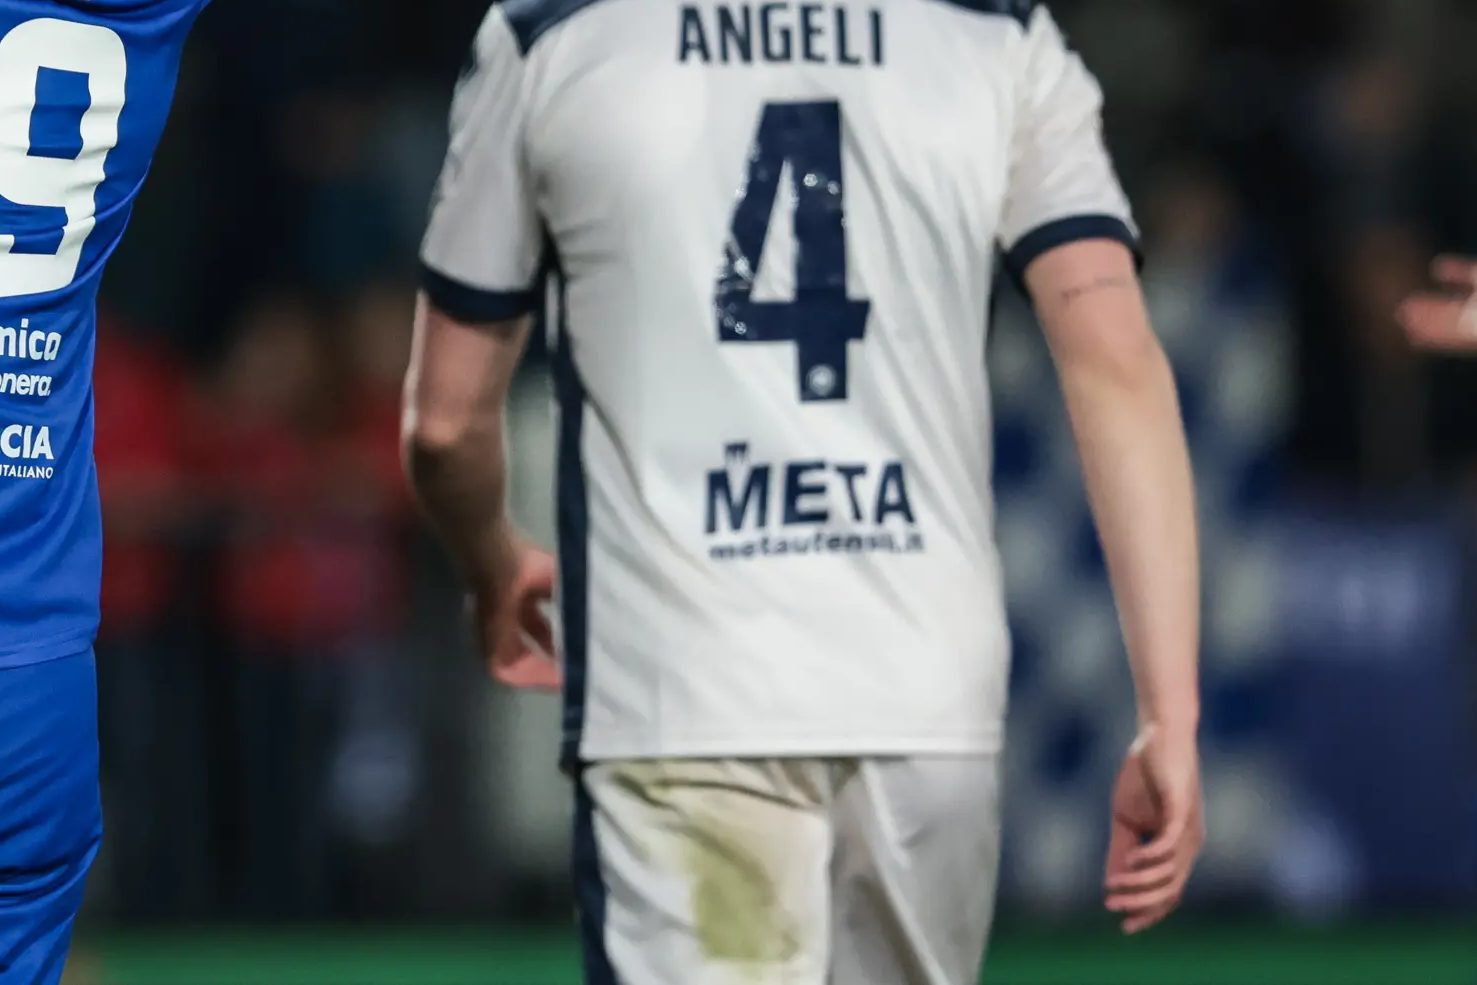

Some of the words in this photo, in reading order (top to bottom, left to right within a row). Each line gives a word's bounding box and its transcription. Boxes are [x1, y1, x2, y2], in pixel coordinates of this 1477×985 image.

[677, 2, 886, 67] ANGELI
[715, 100, 871, 403] 4
[706, 462, 917, 534] META
